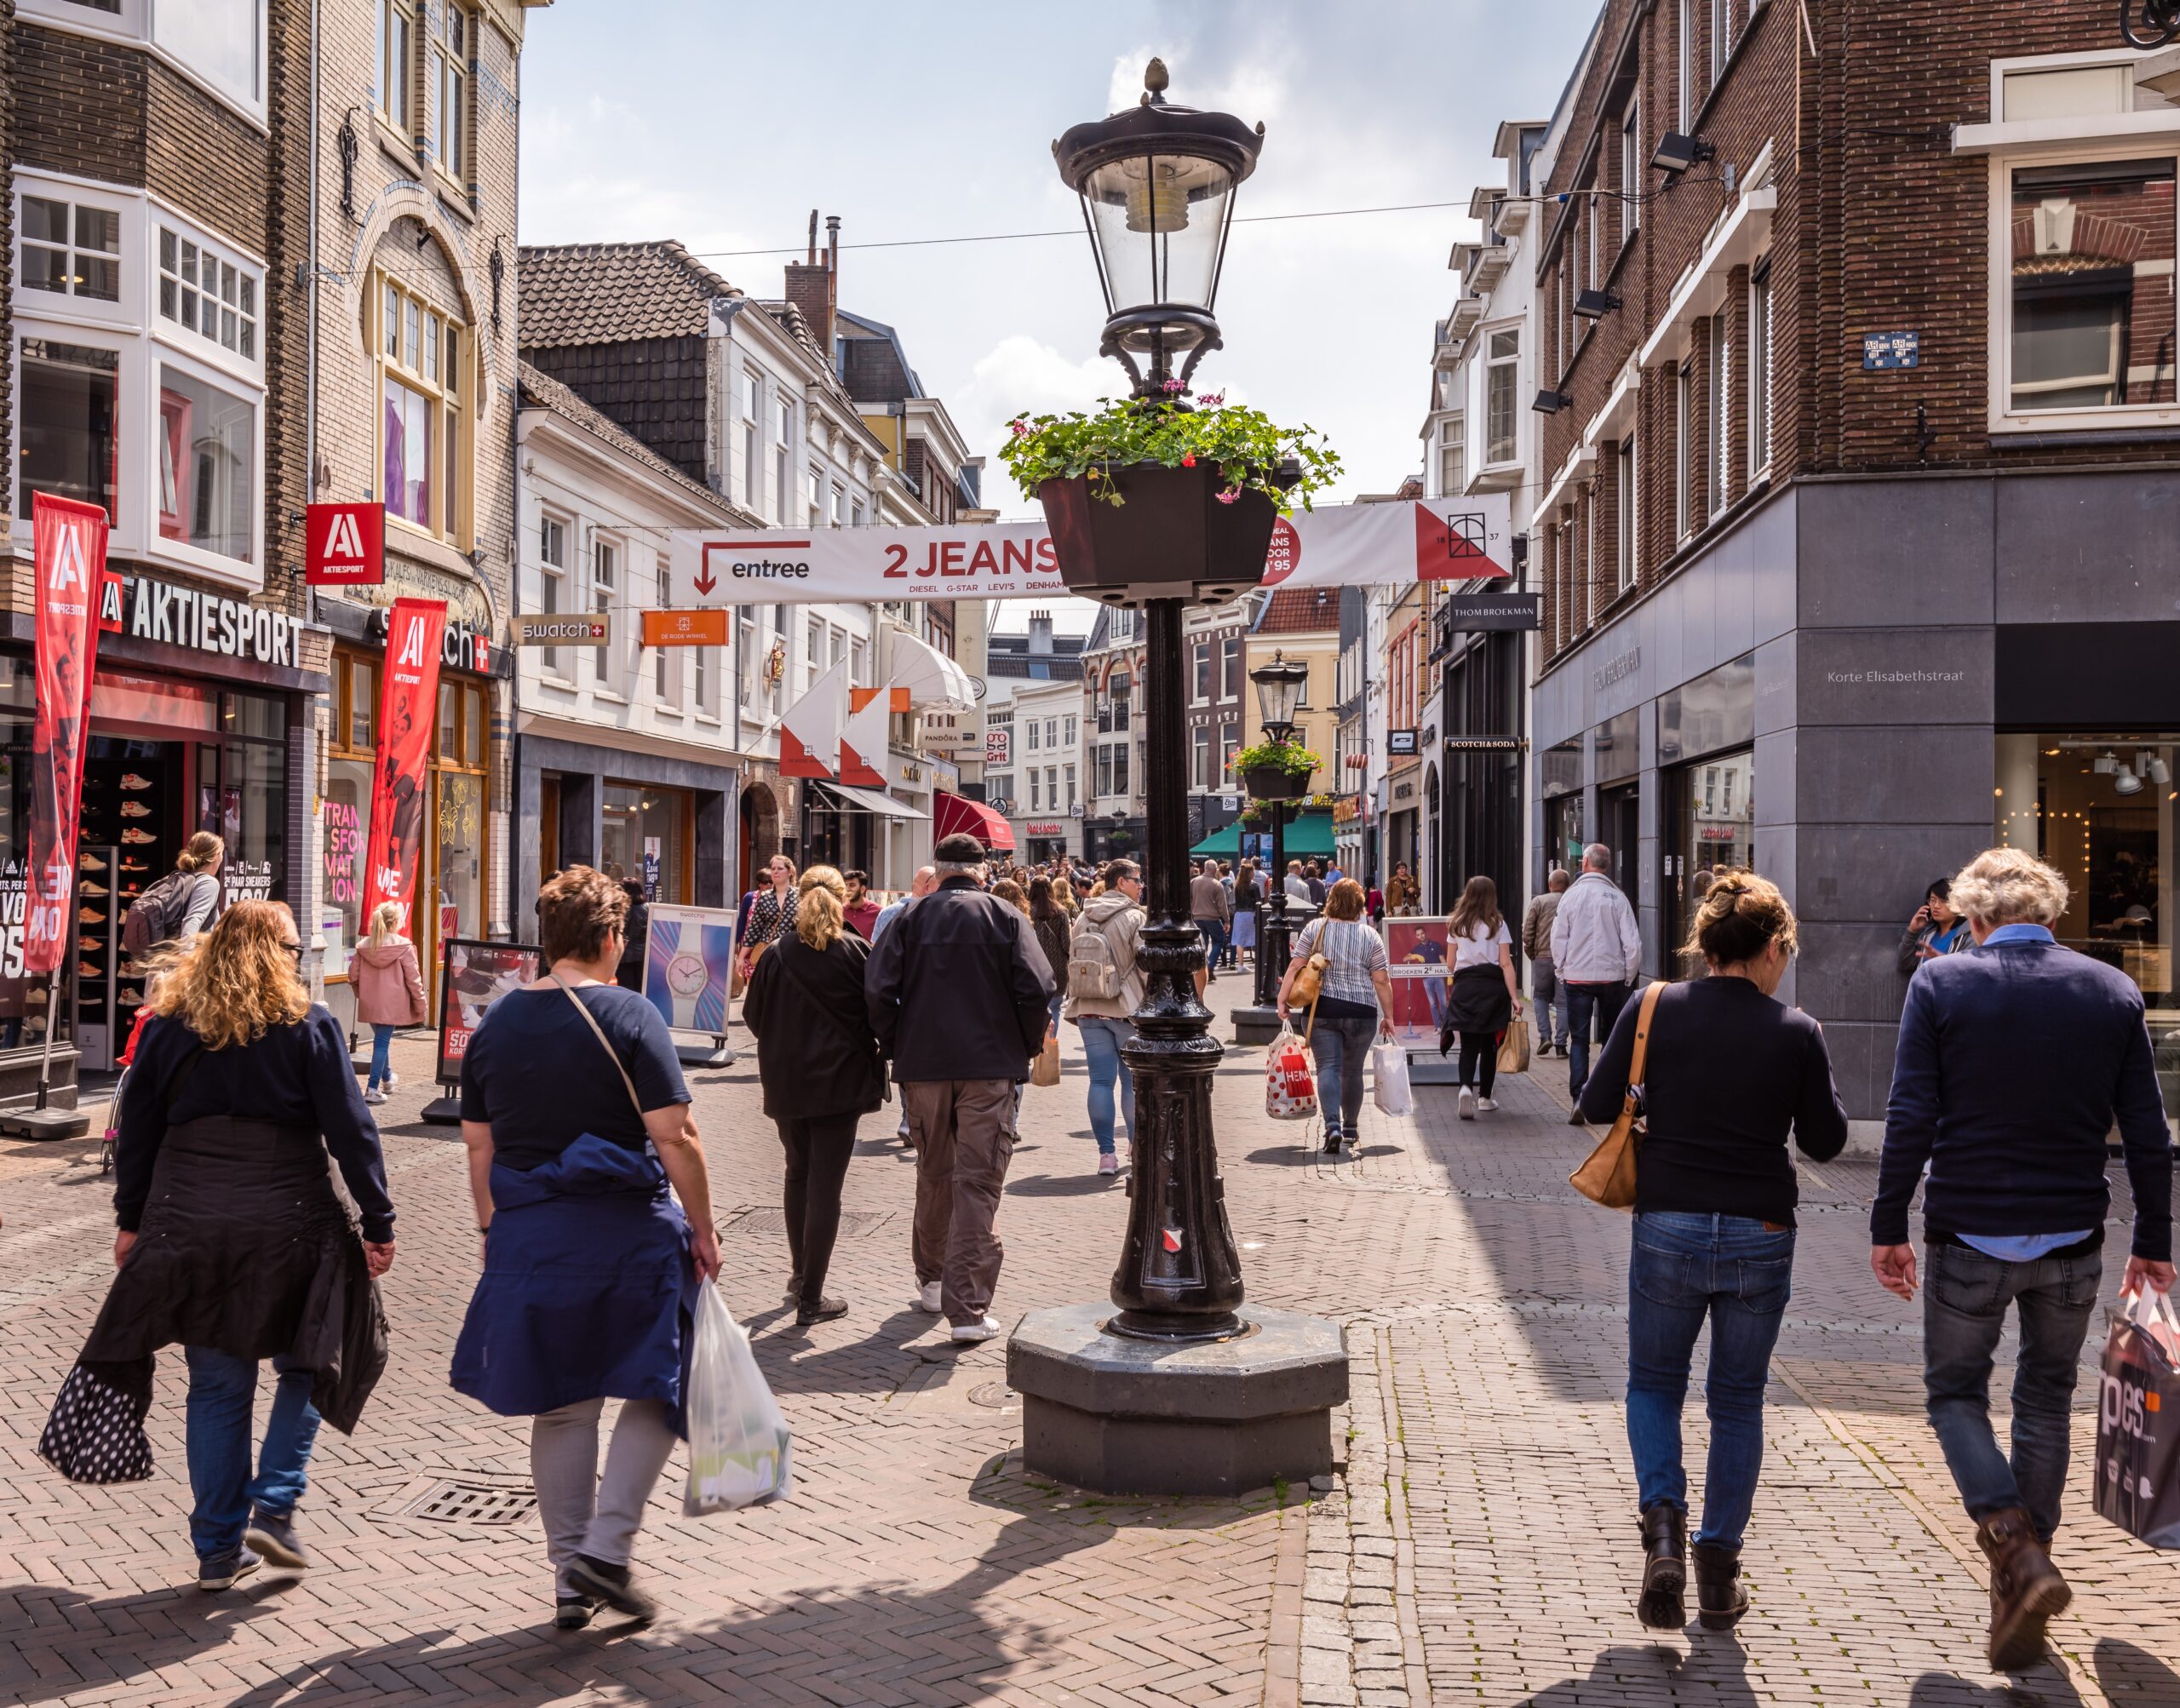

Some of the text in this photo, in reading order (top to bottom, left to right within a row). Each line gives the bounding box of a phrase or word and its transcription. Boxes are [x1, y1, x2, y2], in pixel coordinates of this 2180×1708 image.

[1270, 537, 1290, 547] ANS
[1489, 533, 1500, 542] 37
[883, 537, 1060, 578] 2 JEANS
[1267, 548, 1290, 558] OOR
[731, 559, 810, 580] entree
[909, 581, 1064, 593] DIESEL G-STAR LEVI'S DENHAM
[1454, 607, 1534, 617] THOM BROEKMAN
[133, 578, 305, 668] AKTIESPORT
[522, 622, 592, 639] swatch
[394, 673, 422, 685] AKTIESPORT
[1827, 669, 1965, 683] Korte Elisabethstraat
[1450, 740, 1516, 748] SCOTCH&SODA
[987, 753, 1007, 762] Grit
[324, 802, 360, 828] TRAN
[11, 880, 22, 891] PER
[231, 876, 244, 887] PAAR
[244, 876, 271, 887] SNEAKERS
[331, 878, 356, 903] ION
[449, 1033, 471, 1048] 50
